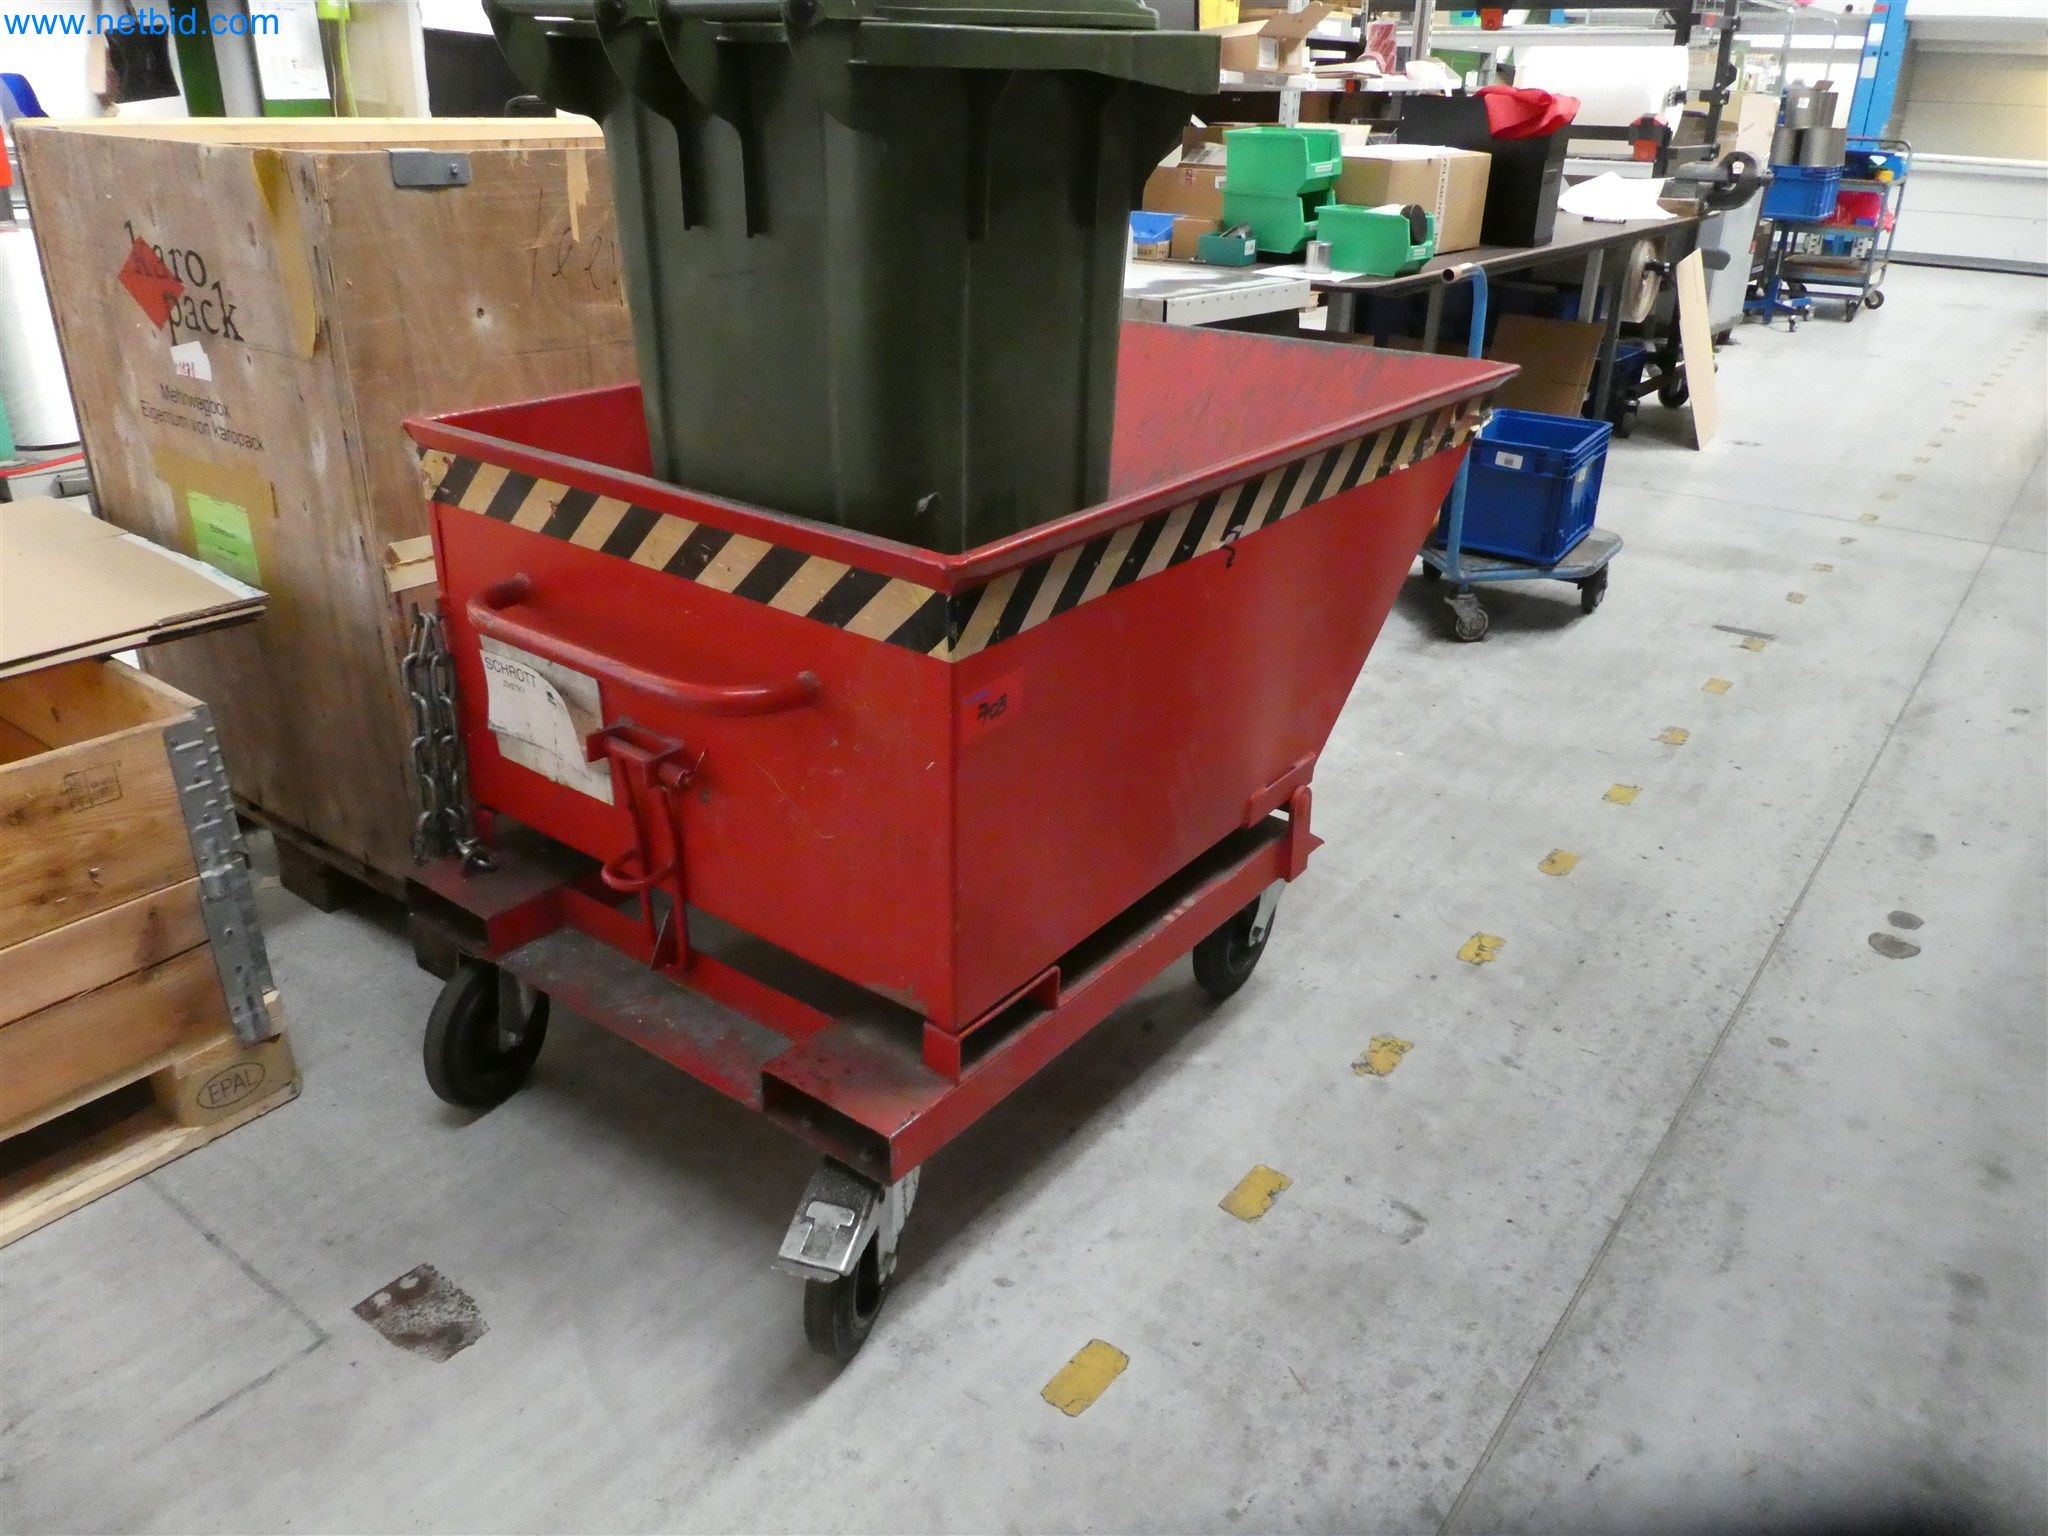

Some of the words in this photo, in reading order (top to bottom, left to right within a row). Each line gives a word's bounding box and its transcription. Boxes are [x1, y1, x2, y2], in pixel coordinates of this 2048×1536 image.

[163, 279, 245, 347] pack
[484, 656, 536, 687] SCHROTT
[207, 1069, 258, 1104] EPAL
